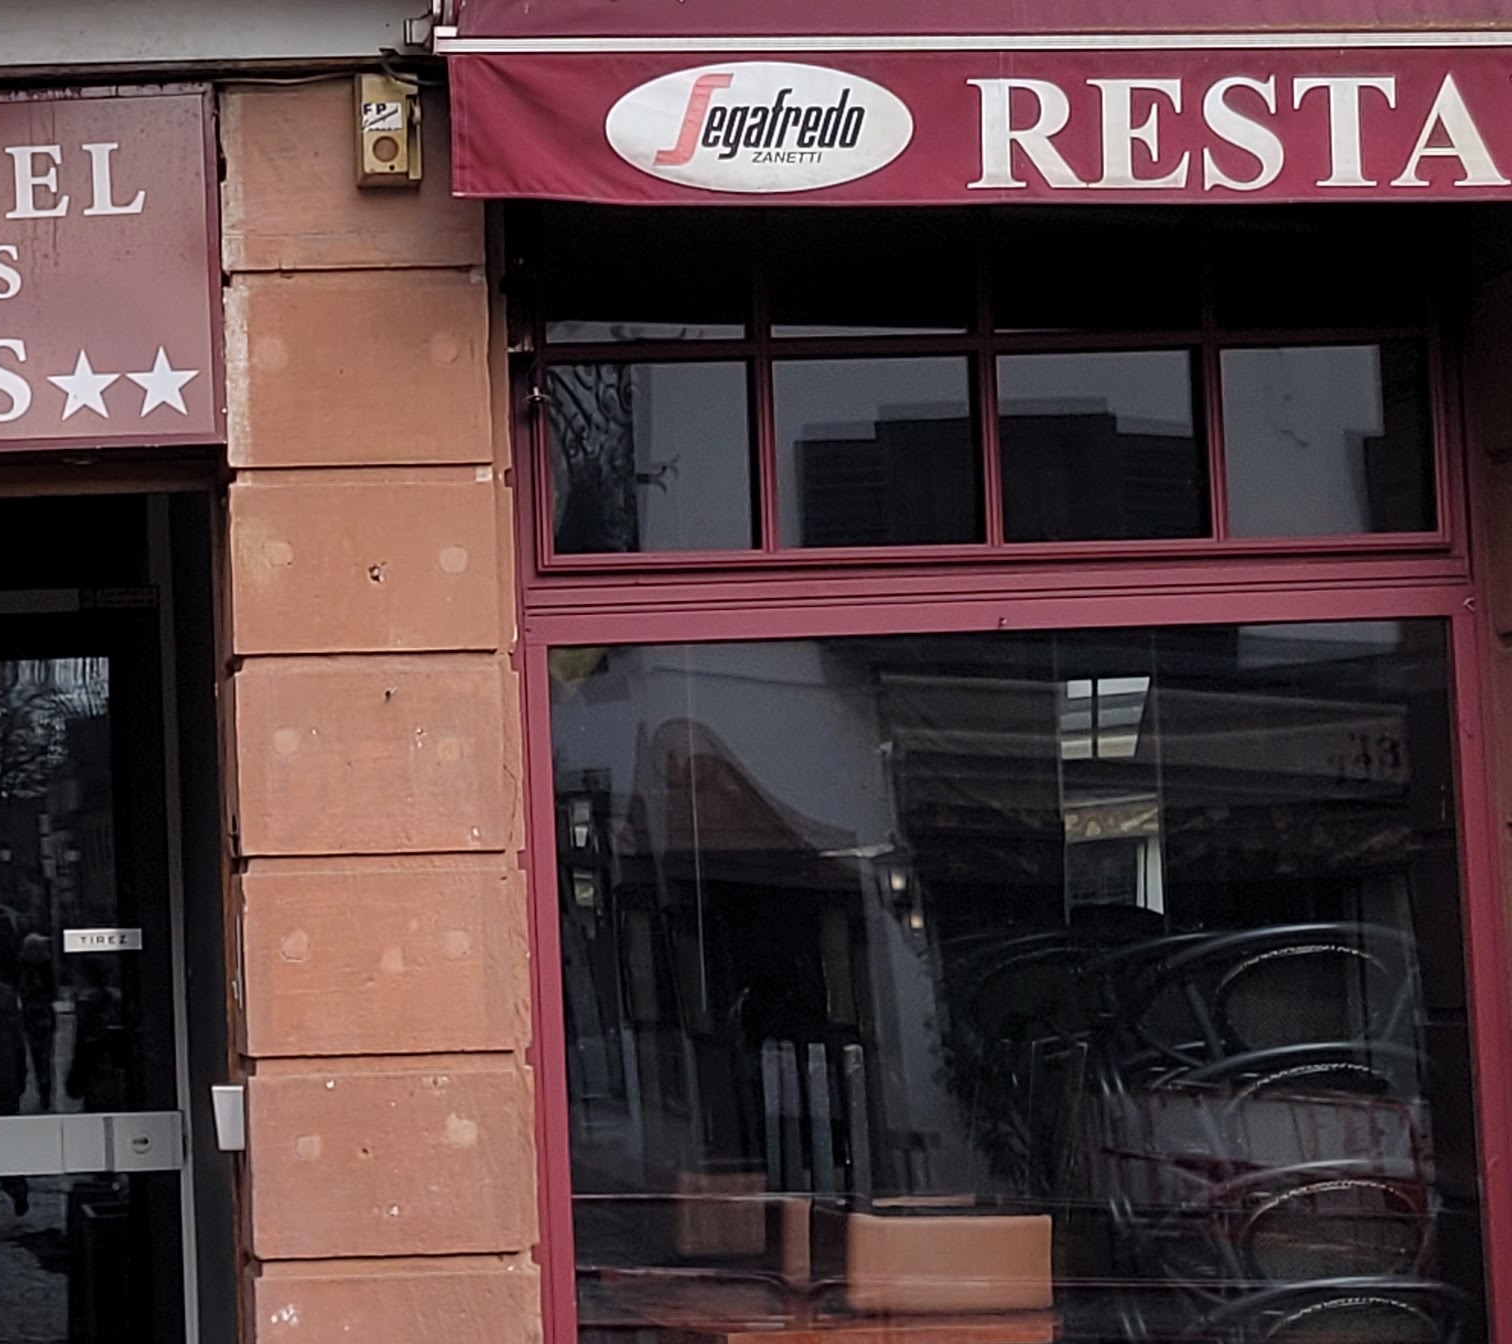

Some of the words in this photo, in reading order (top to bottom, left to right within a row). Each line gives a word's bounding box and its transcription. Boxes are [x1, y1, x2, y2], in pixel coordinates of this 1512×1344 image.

[653, 72, 866, 167] Segafredo
[751, 151, 822, 164] ZANETTI
[80, 934, 129, 945] TIREZ
